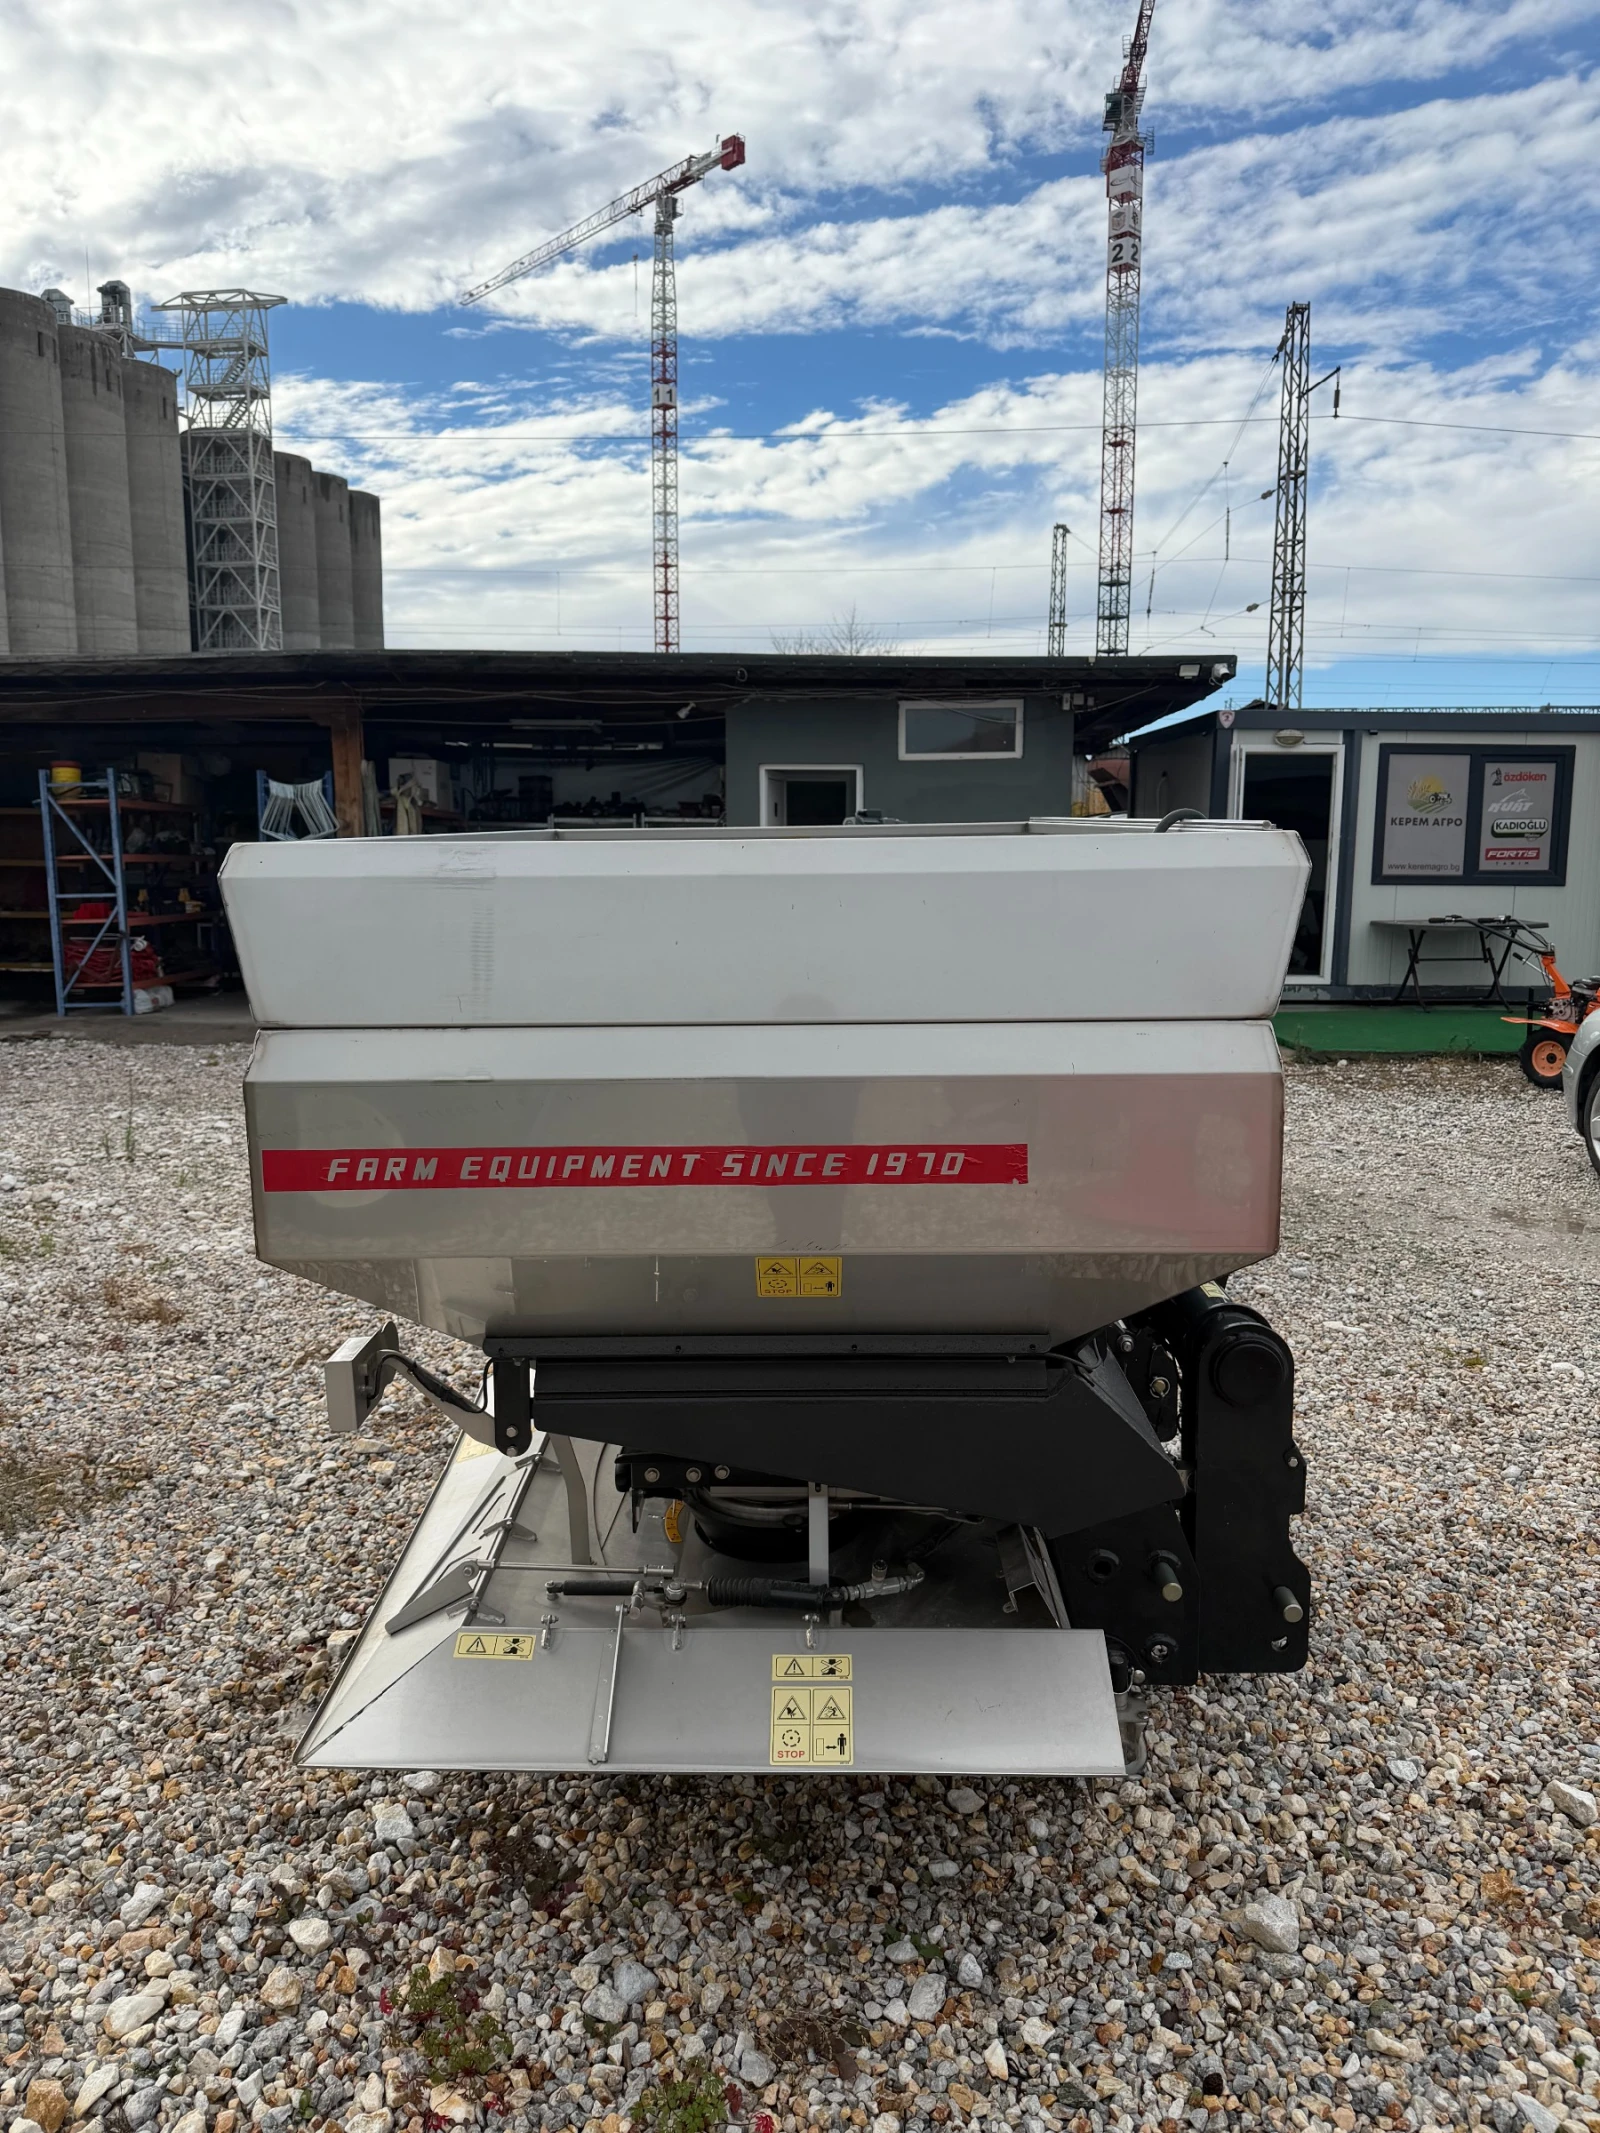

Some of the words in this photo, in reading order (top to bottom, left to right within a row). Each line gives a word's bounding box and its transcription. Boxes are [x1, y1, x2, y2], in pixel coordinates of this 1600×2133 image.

[1112, 243, 1124, 263] 2
[1130, 243, 1138, 263] 2
[654, 388, 660, 402] 1
[666, 388, 672, 402] 1
[1503, 770, 1547, 782] özdöken
[1390, 817, 1429, 826] КЕРЕМ
[1432, 817, 1463, 827] АГРО
[1495, 819, 1546, 830] KADIOĞLU
[1388, 863, 1461, 872] www.keremagro.bg
[328, 1157, 439, 1181] FARM
[459, 1154, 702, 1182] EQUIPMENT
[720, 1152, 847, 1178] SINCE
[866, 1152, 966, 1176] 1970
[777, 1750, 805, 1759] STOP
